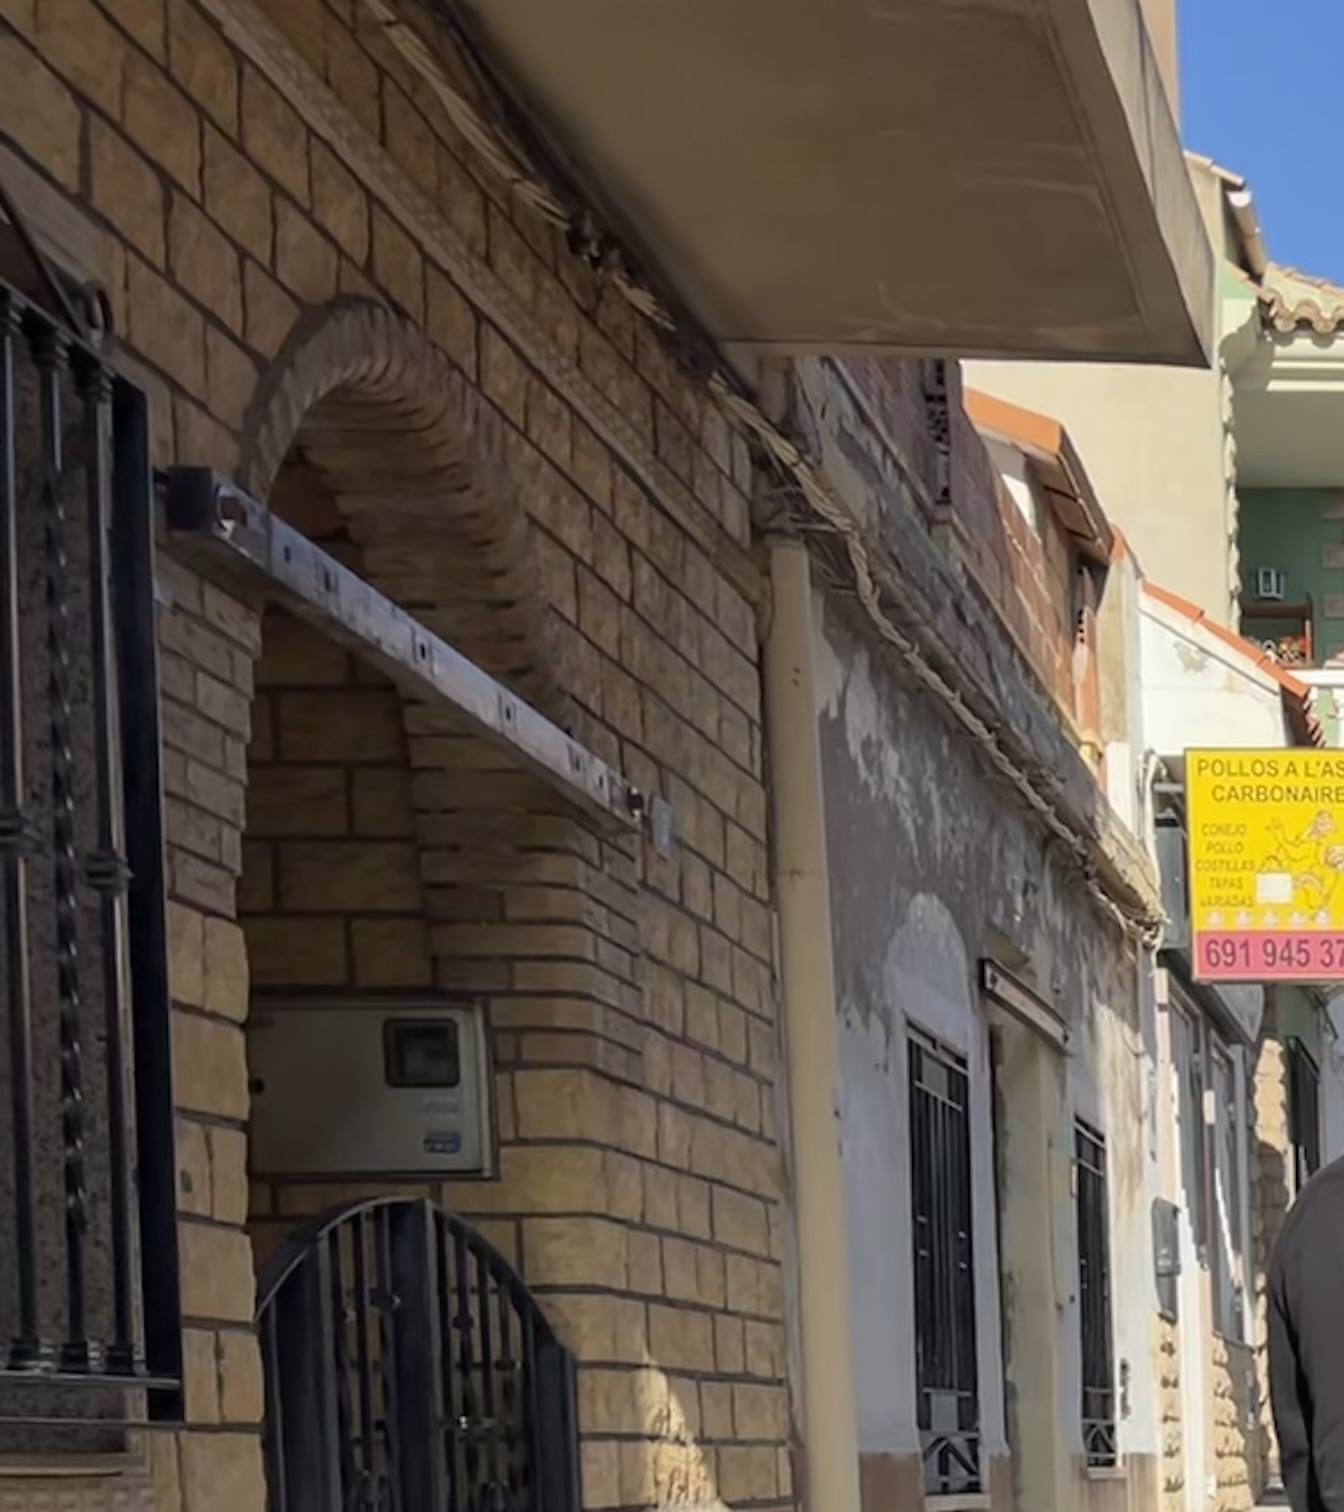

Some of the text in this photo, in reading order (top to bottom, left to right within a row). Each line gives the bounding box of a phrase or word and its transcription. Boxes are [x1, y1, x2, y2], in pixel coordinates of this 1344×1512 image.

[1197, 759, 1279, 778] POLLOS
[1284, 760, 1300, 778] A
[1201, 823, 1247, 836] CONEJO
[1206, 842, 1244, 854] POLLO
[1195, 860, 1255, 872] COSTILLAS
[1209, 878, 1244, 890] TAPAS
[1200, 895, 1254, 908] VARIADAS
[1206, 938, 1251, 968] 691
[1262, 938, 1311, 968] 945
